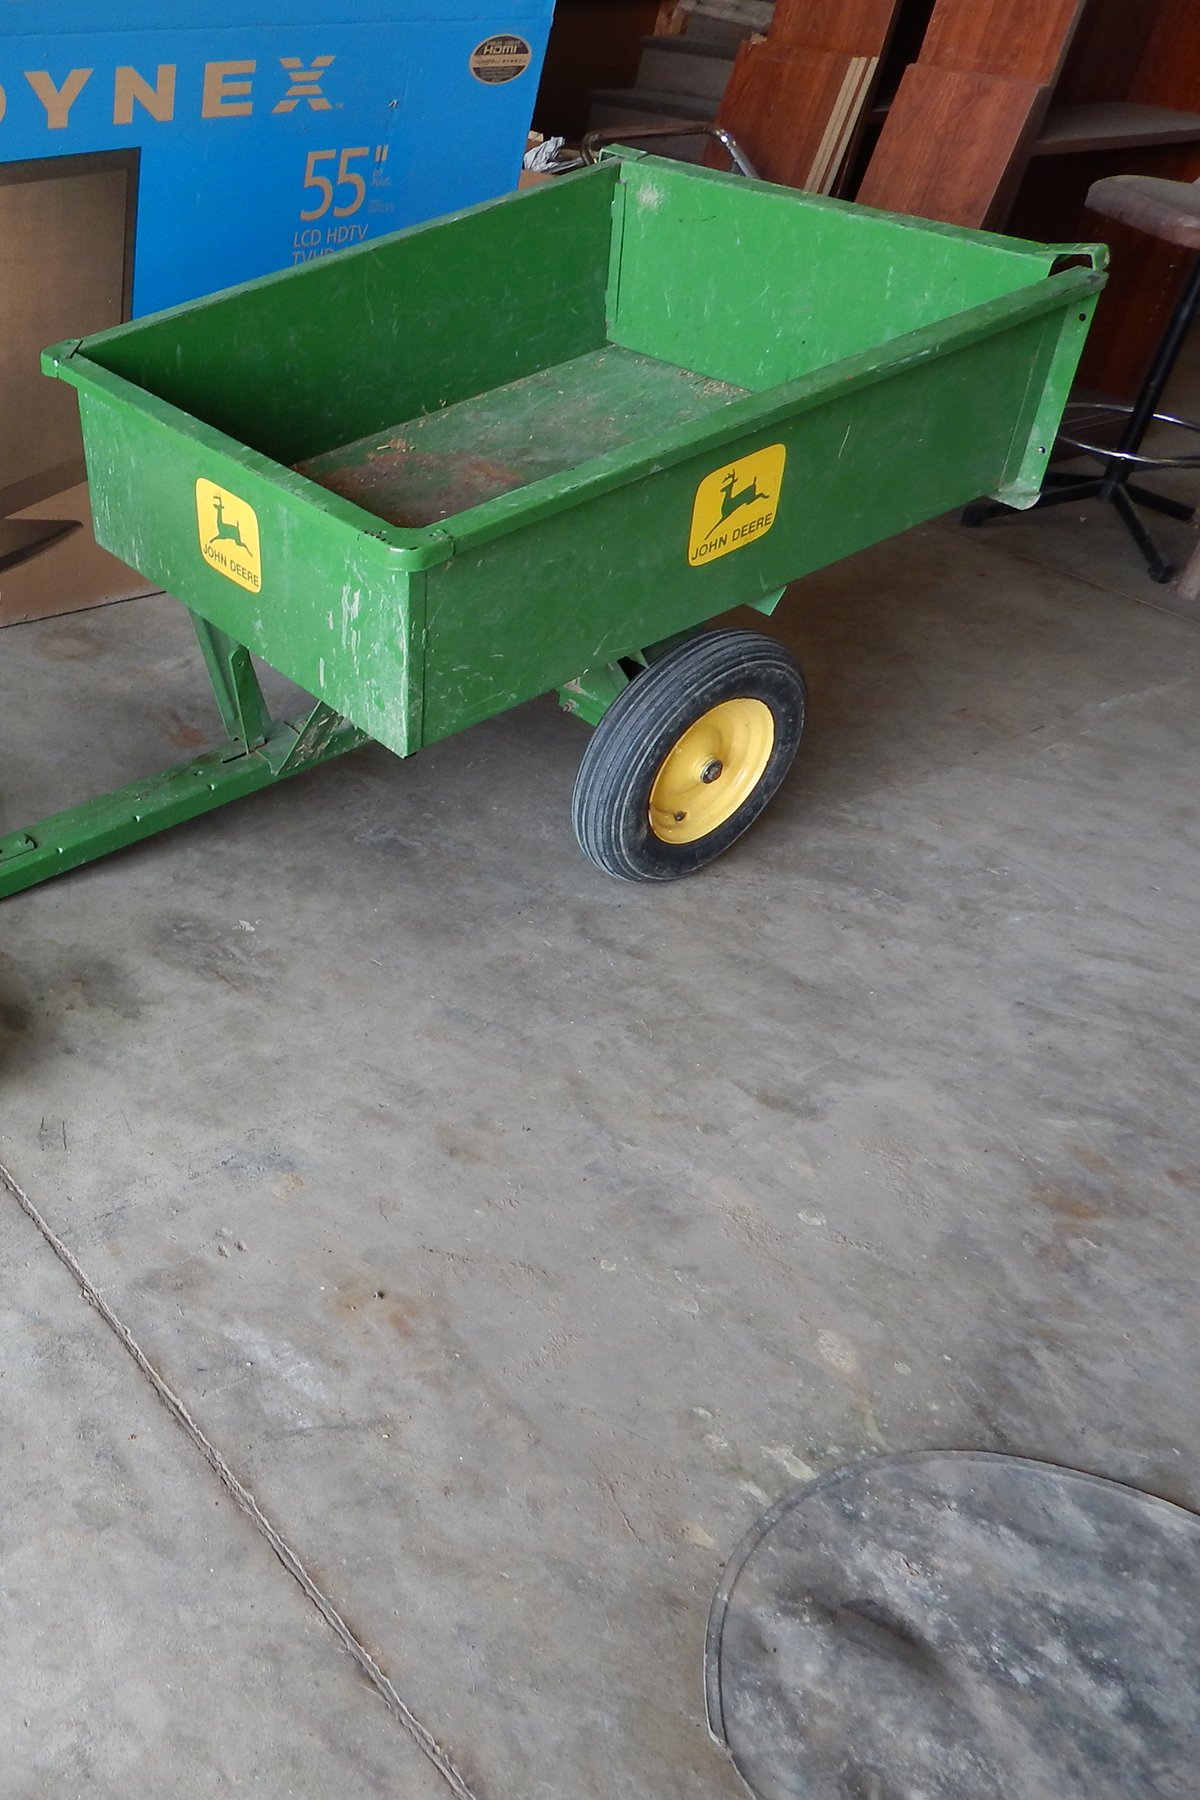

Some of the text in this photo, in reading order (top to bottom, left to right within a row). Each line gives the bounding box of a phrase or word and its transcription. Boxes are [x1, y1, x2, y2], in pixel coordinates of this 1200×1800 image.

[292, 224, 369, 249] LCD HDTV
[691, 512, 773, 561] JOHN DEERE
[203, 544, 259, 587] JOHN DEERE
